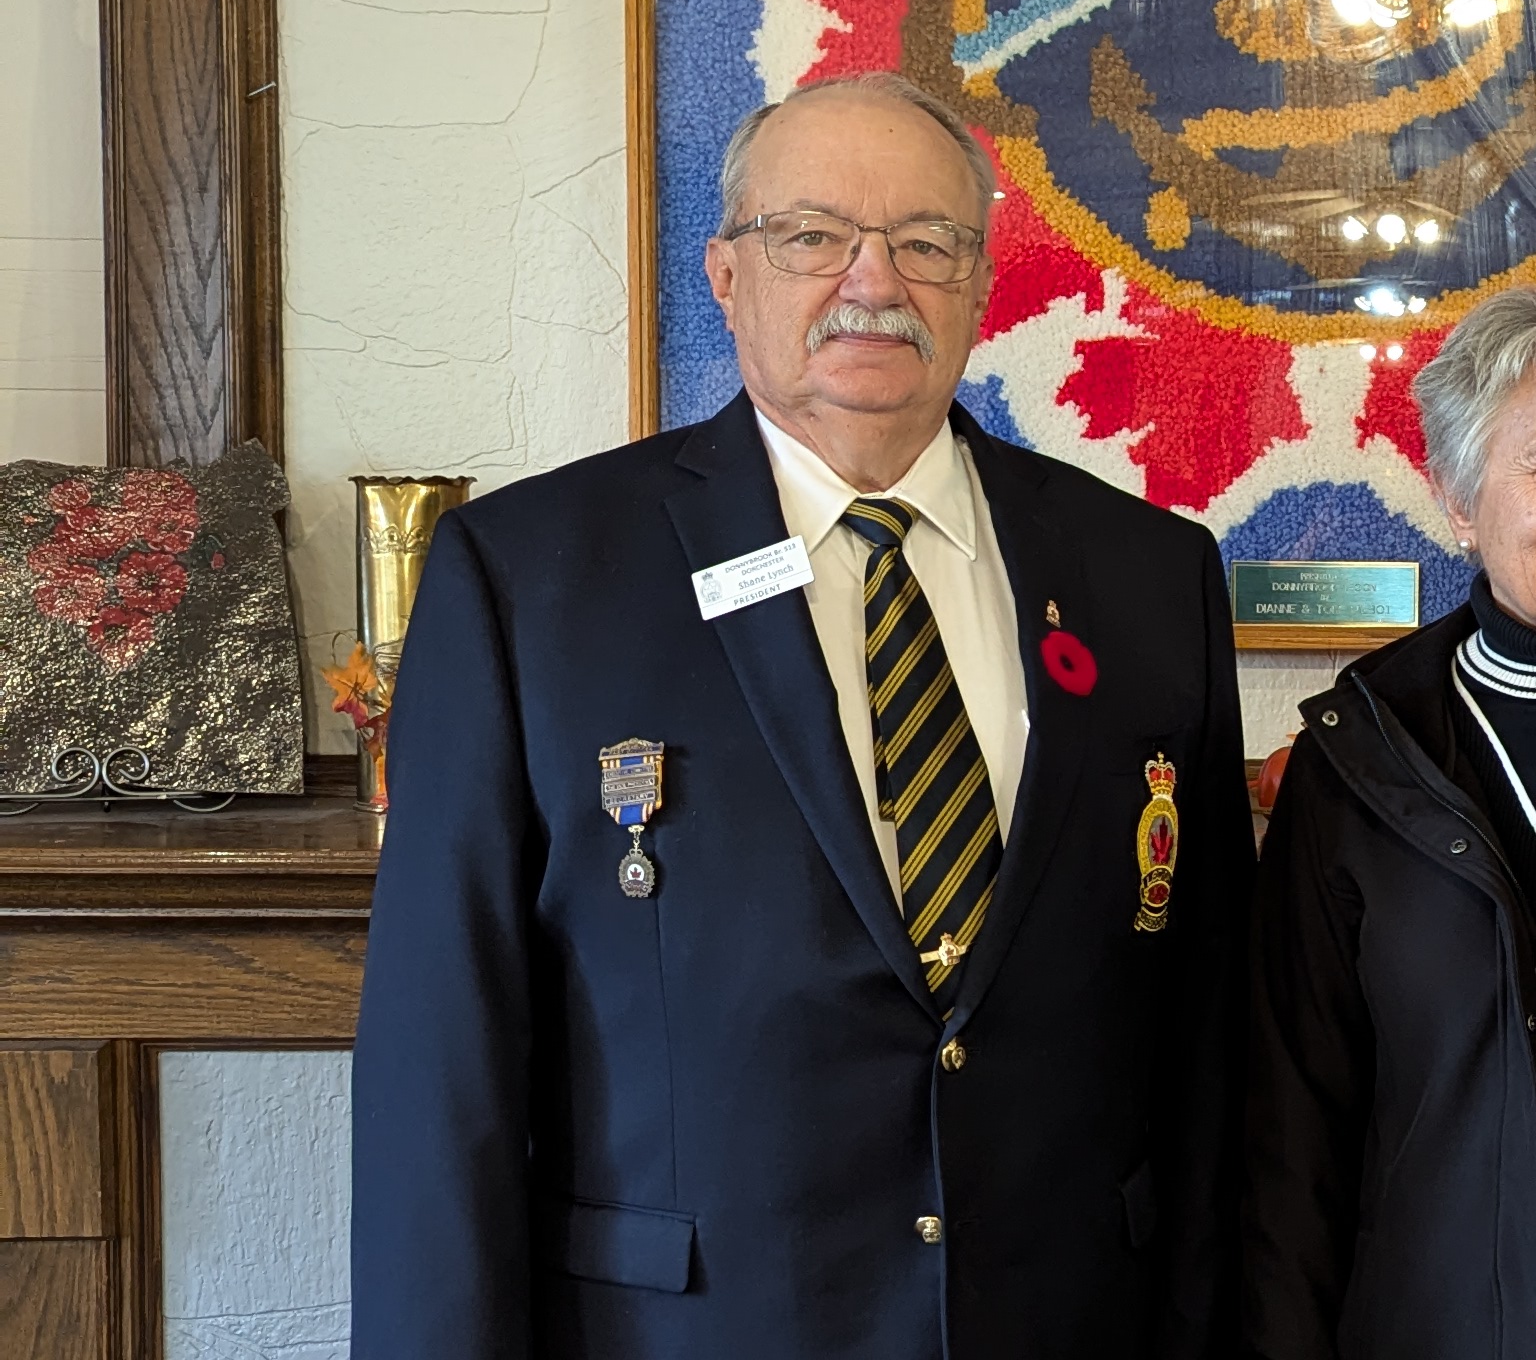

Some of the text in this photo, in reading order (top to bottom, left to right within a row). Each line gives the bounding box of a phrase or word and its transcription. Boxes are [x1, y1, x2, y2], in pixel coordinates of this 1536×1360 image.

[741, 555, 785, 576] DORCHESTER
[738, 563, 795, 591] Shane Lynch
[733, 583, 781, 607] PRESIDENT
[1256, 603, 1297, 614] DIANNE
[1300, 603, 1311, 614] &
